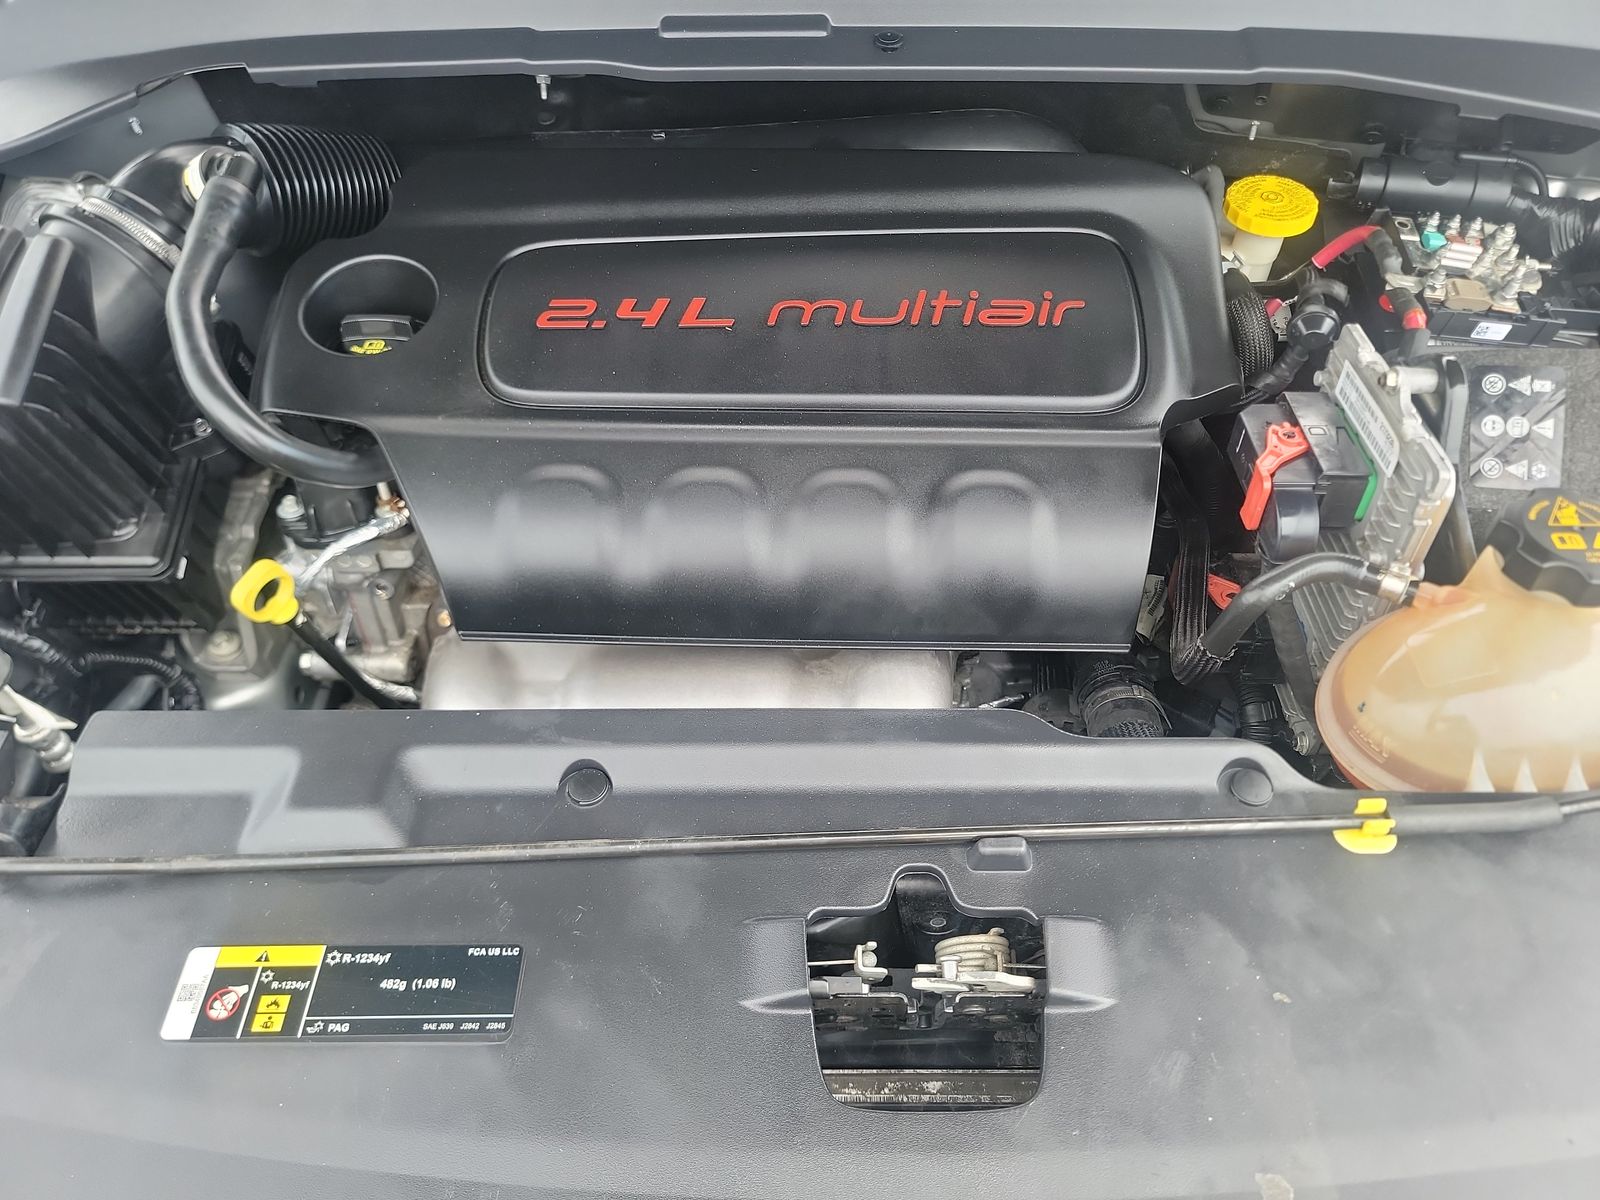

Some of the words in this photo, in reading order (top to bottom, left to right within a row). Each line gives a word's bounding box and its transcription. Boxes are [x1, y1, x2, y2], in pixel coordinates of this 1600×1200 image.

[767, 289, 1086, 327] multiair
[467, 947, 486, 956] FCA
[488, 947, 501, 956] US
[502, 947, 520, 956] LLC
[341, 952, 392, 966] R-1234yf
[271, 980, 311, 991] R-1234yf
[440, 977, 457, 991] lb)
[327, 1022, 350, 1033] PAG
[422, 1022, 438, 1031] SAE
